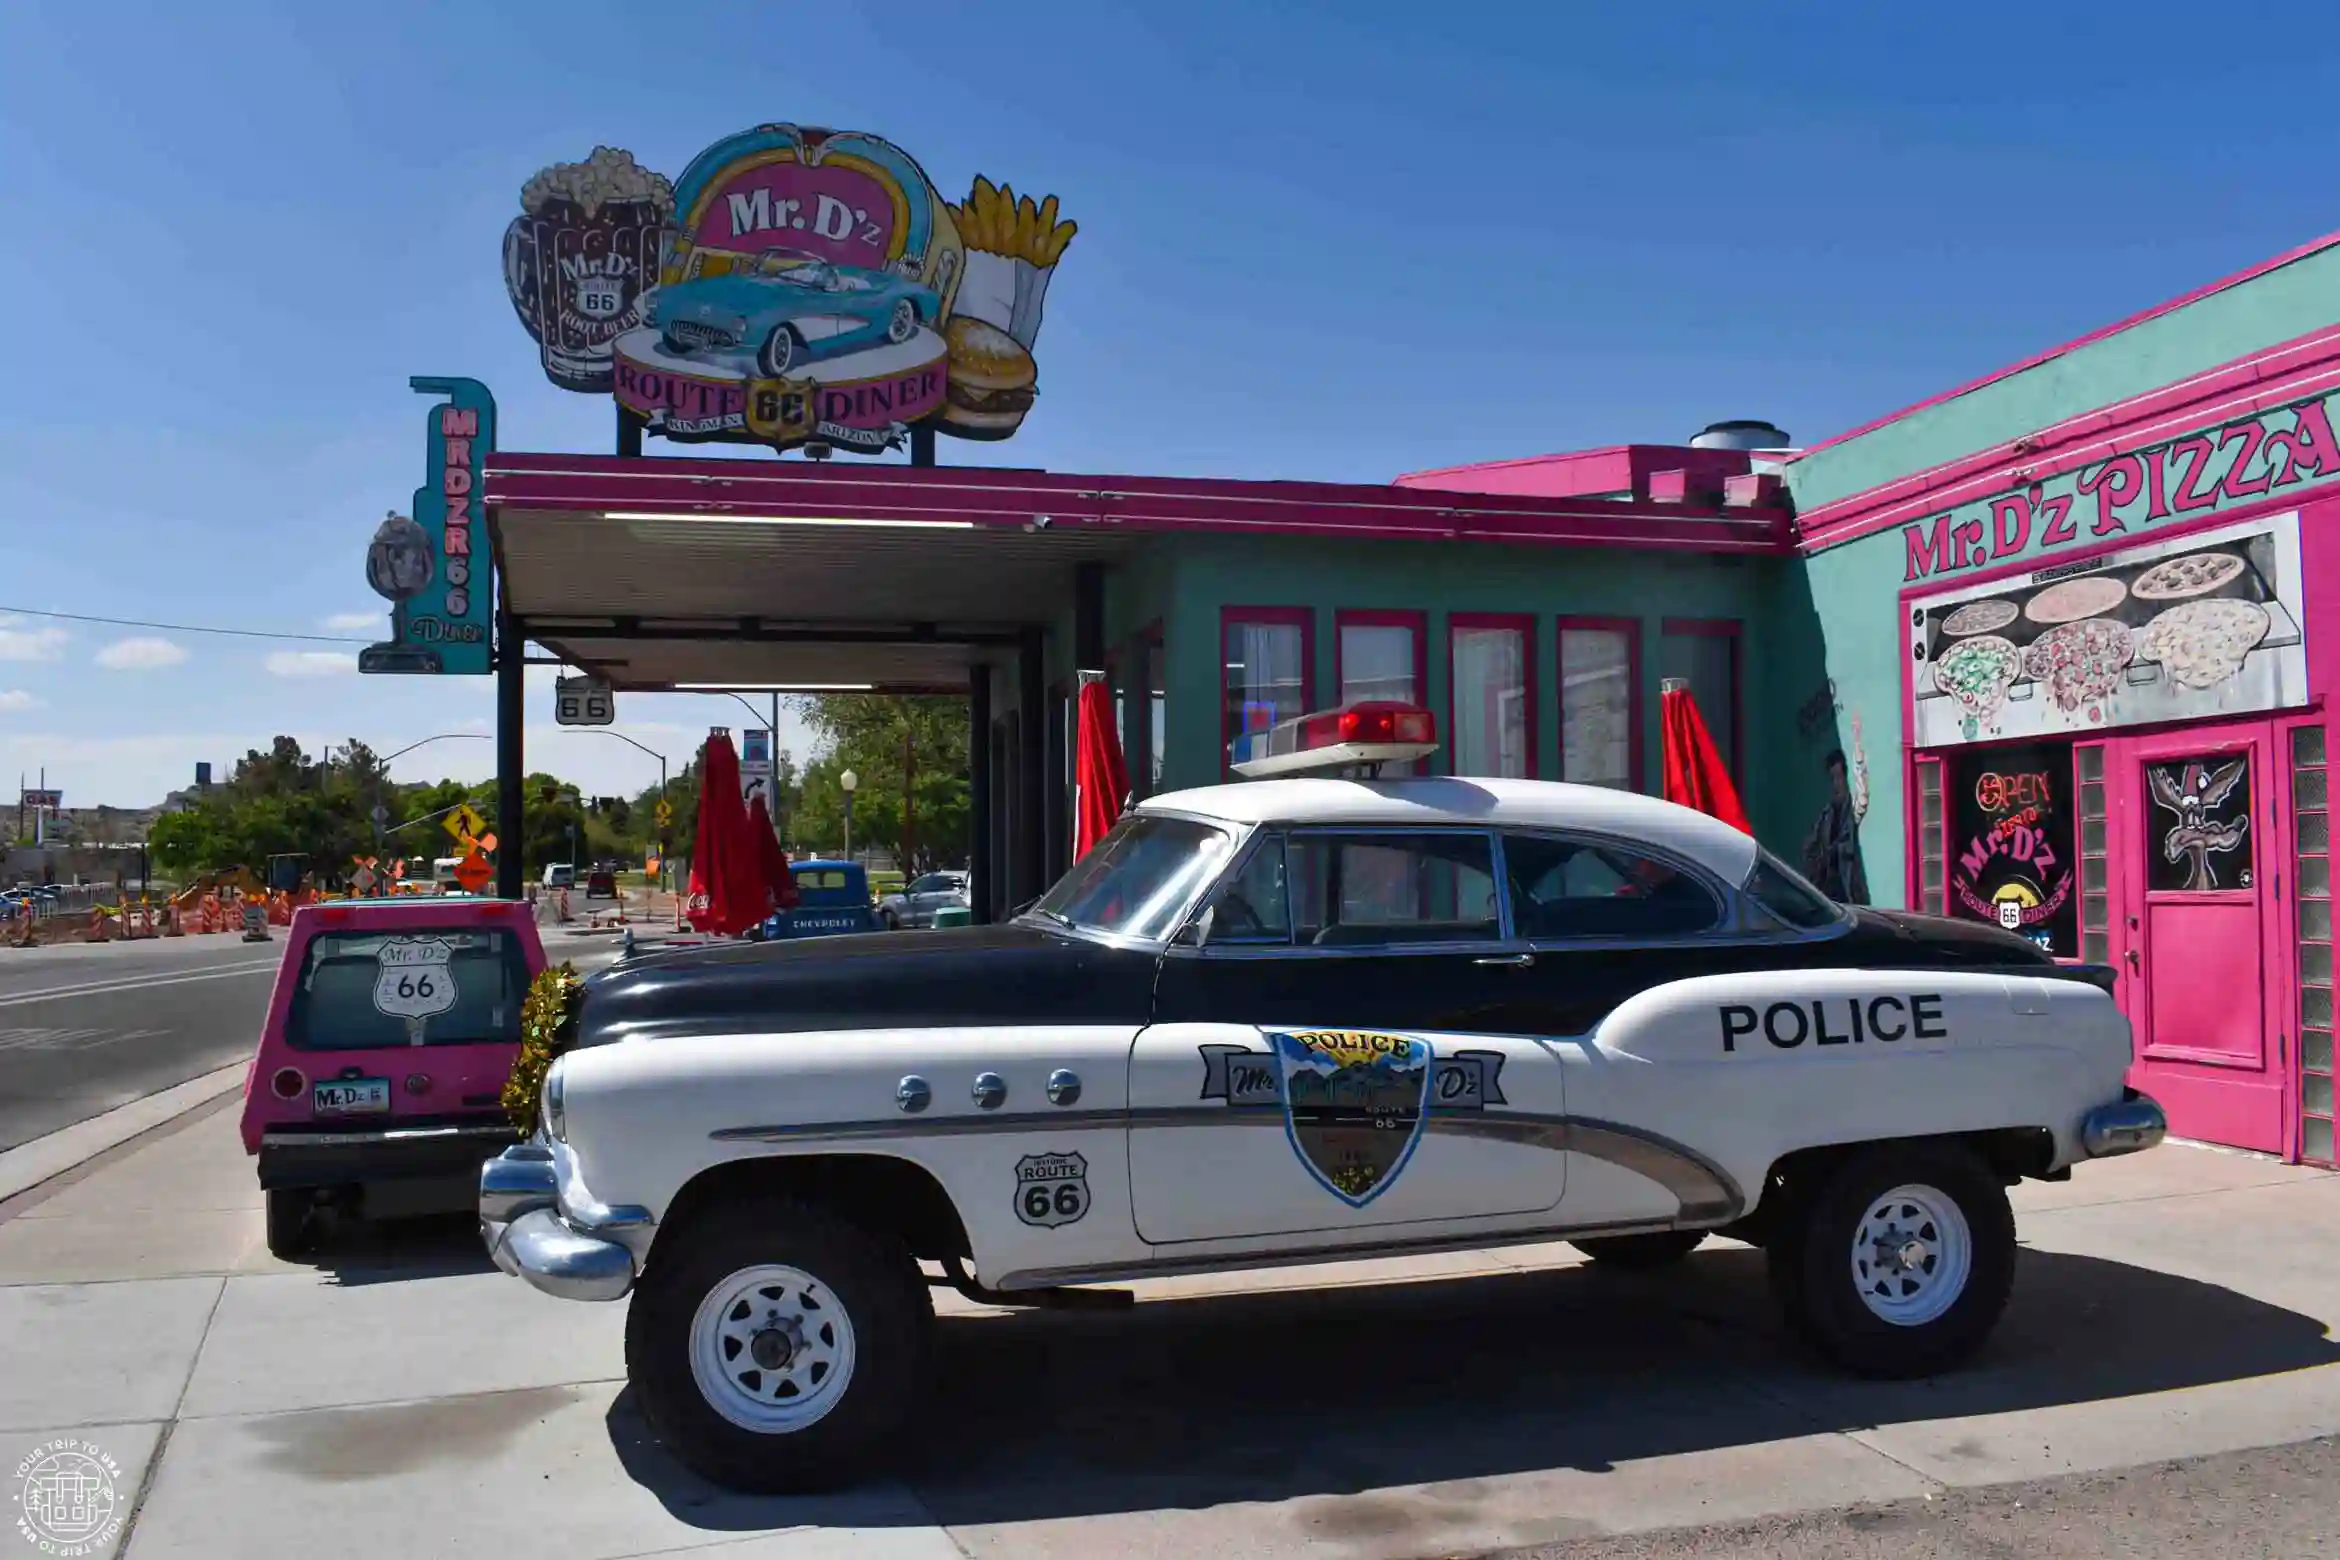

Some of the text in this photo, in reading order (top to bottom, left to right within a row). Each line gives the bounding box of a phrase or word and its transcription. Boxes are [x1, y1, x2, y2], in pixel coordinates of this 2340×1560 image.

[725, 188, 881, 246] Mr. D'z
[586, 293, 615, 311] 66
[560, 308, 640, 336] ROOT BEER
[618, 364, 939, 422] ROUTE 66 DINER
[2078, 398, 2340, 536] PIZZA
[411, 616, 483, 644] Diner
[562, 698, 606, 718] 66
[1976, 772, 2050, 812] OPEN
[1961, 888, 2065, 924] ROUTE 66 DINER
[793, 918, 857, 928] CHEVROLET
[398, 974, 434, 998] 66
[1719, 993, 1948, 1052] POLICE
[1297, 1030, 1412, 1058] POLICE
[1376, 1118, 1396, 1129] 66
[1024, 1165, 1078, 1179] ROUTE
[1025, 1184, 1080, 1218] 66
